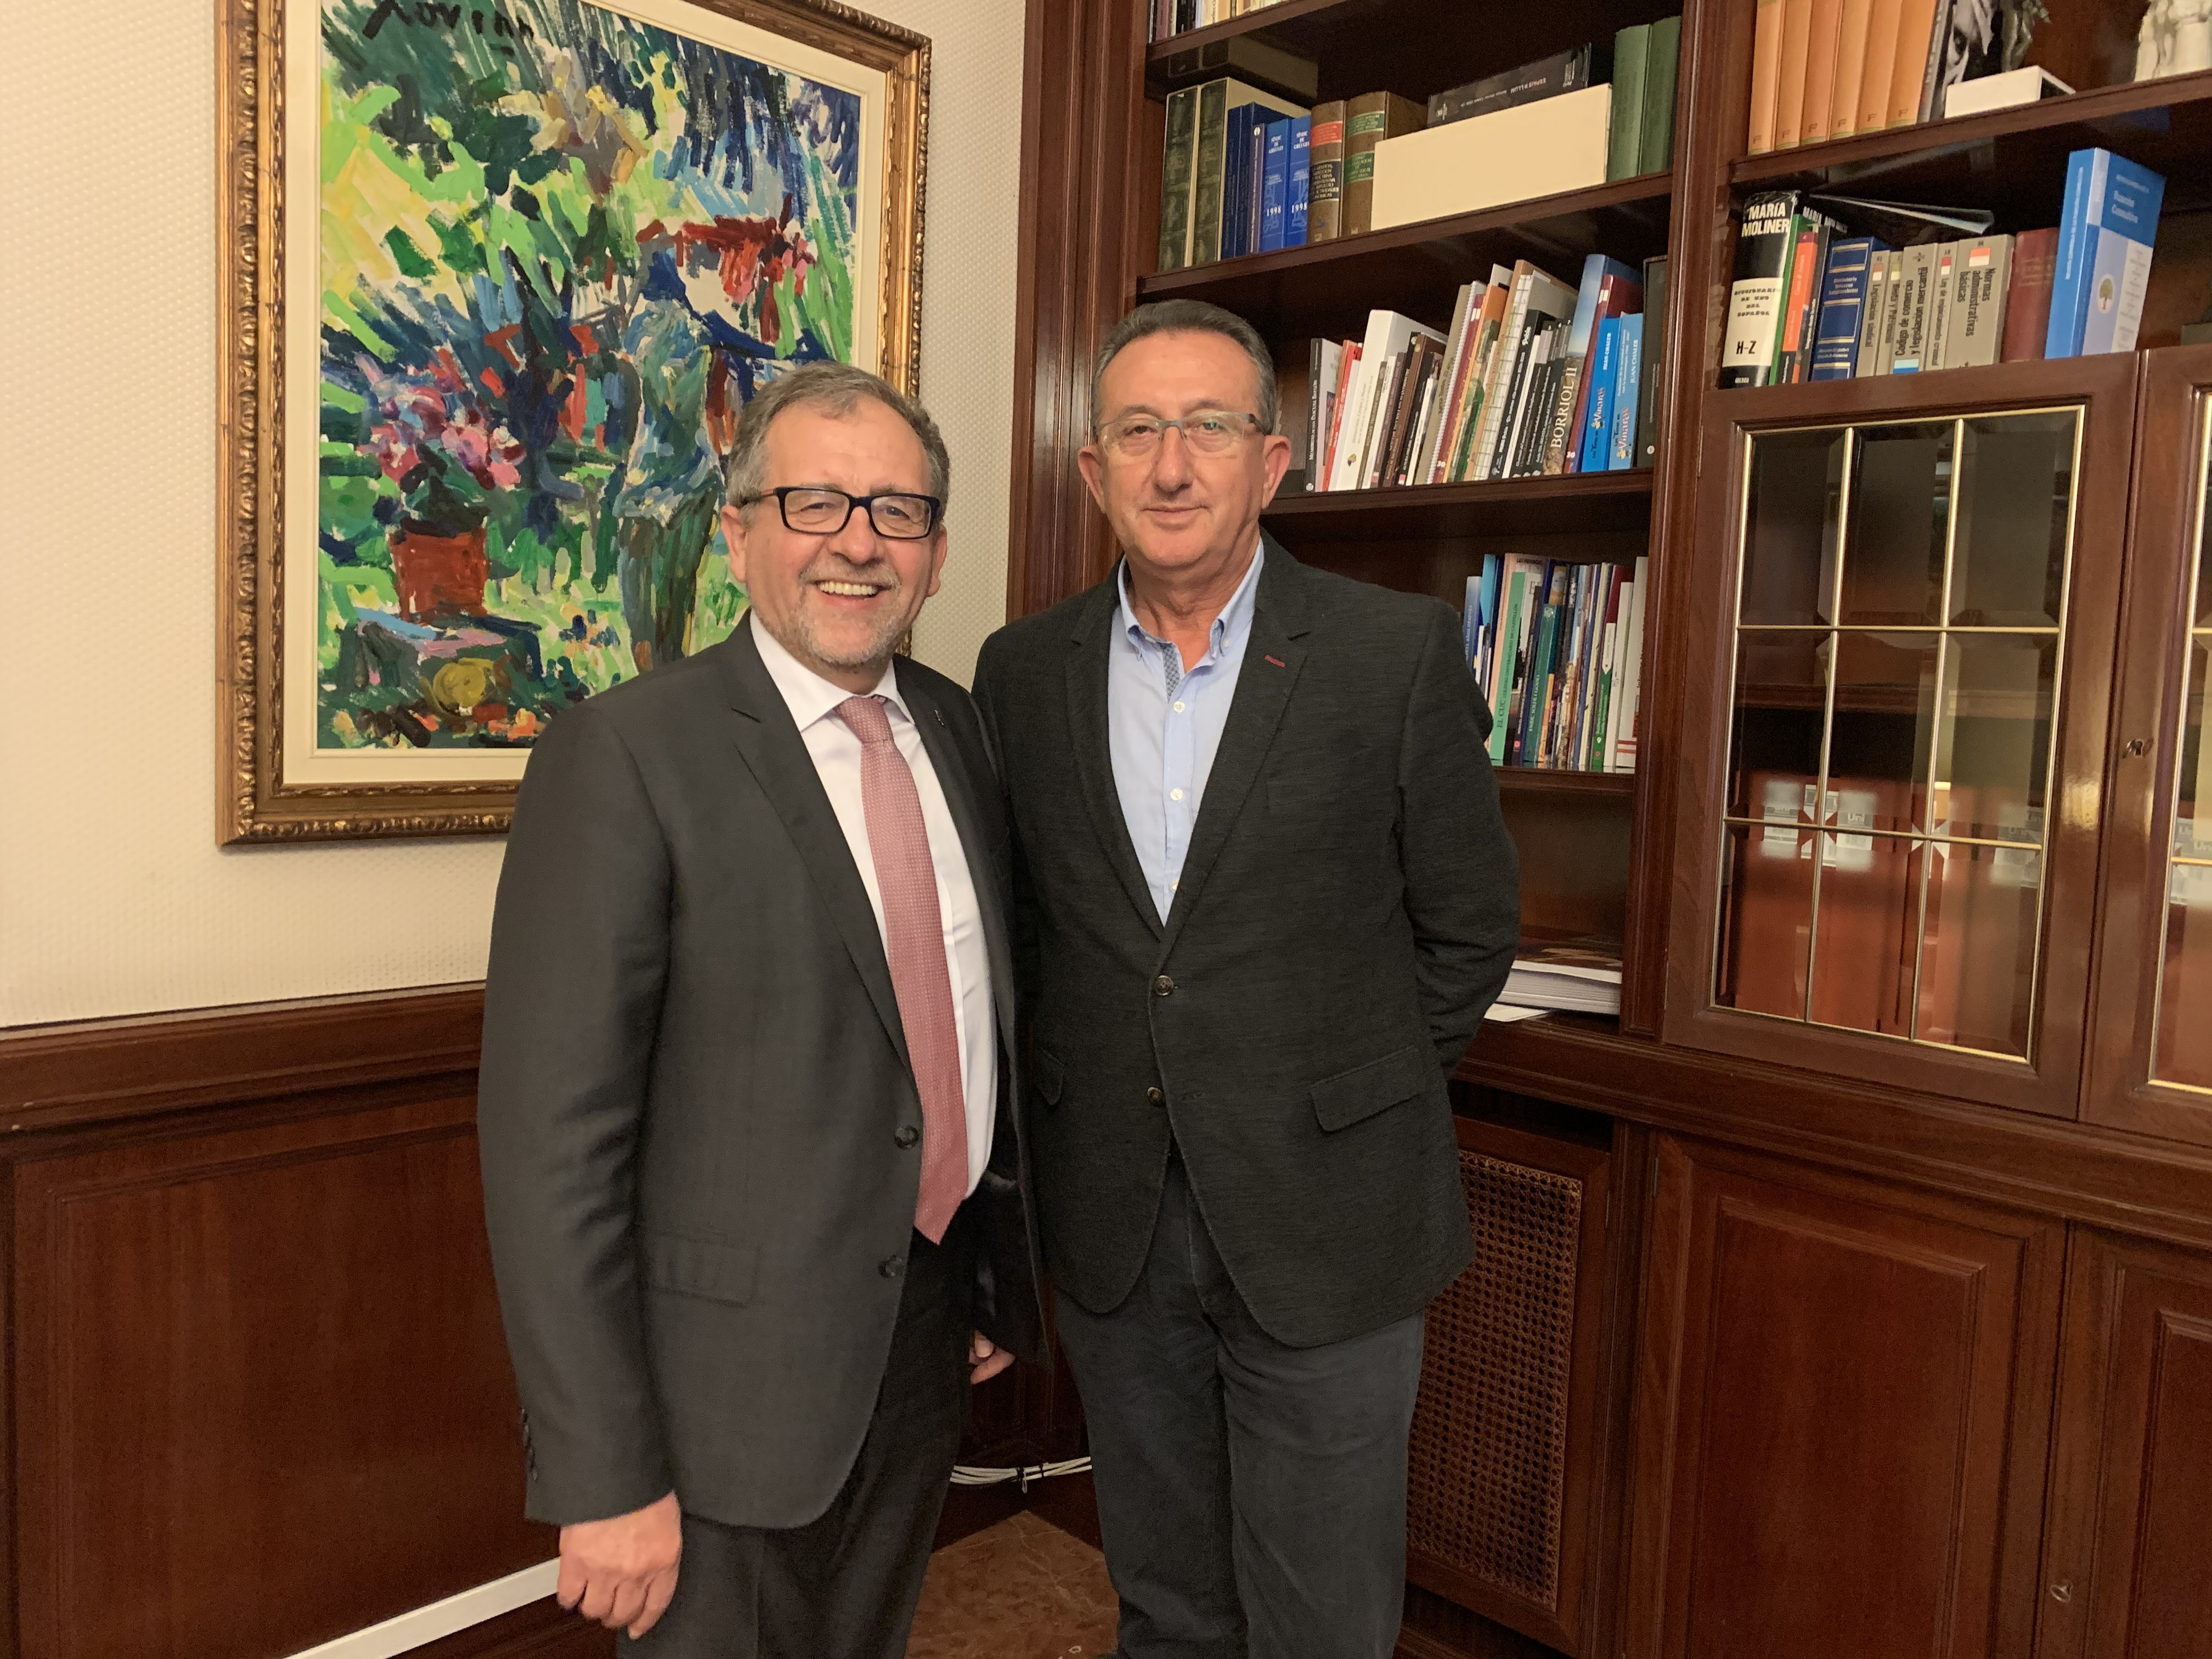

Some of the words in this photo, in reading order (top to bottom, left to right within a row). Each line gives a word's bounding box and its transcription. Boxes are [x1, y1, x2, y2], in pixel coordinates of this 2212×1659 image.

[1266, 205, 1282, 216] 1998
[1291, 202, 1307, 213] 1998
[1748, 202, 1785, 221] MARÍA
[1741, 218, 1791, 237] MOLINER
[1915, 266, 1928, 304] mercantil
[1980, 267, 1996, 302] Normas
[1900, 279, 1913, 315] comercio
[1965, 269, 1983, 337] administrativas
[1898, 317, 1909, 328] de
[1736, 341, 1757, 354] H-Z
[1894, 329, 1908, 357] Código
[1550, 378, 1575, 449] BORRIOL
[1564, 365, 1577, 378] II
[1496, 718, 1503, 727] EL
